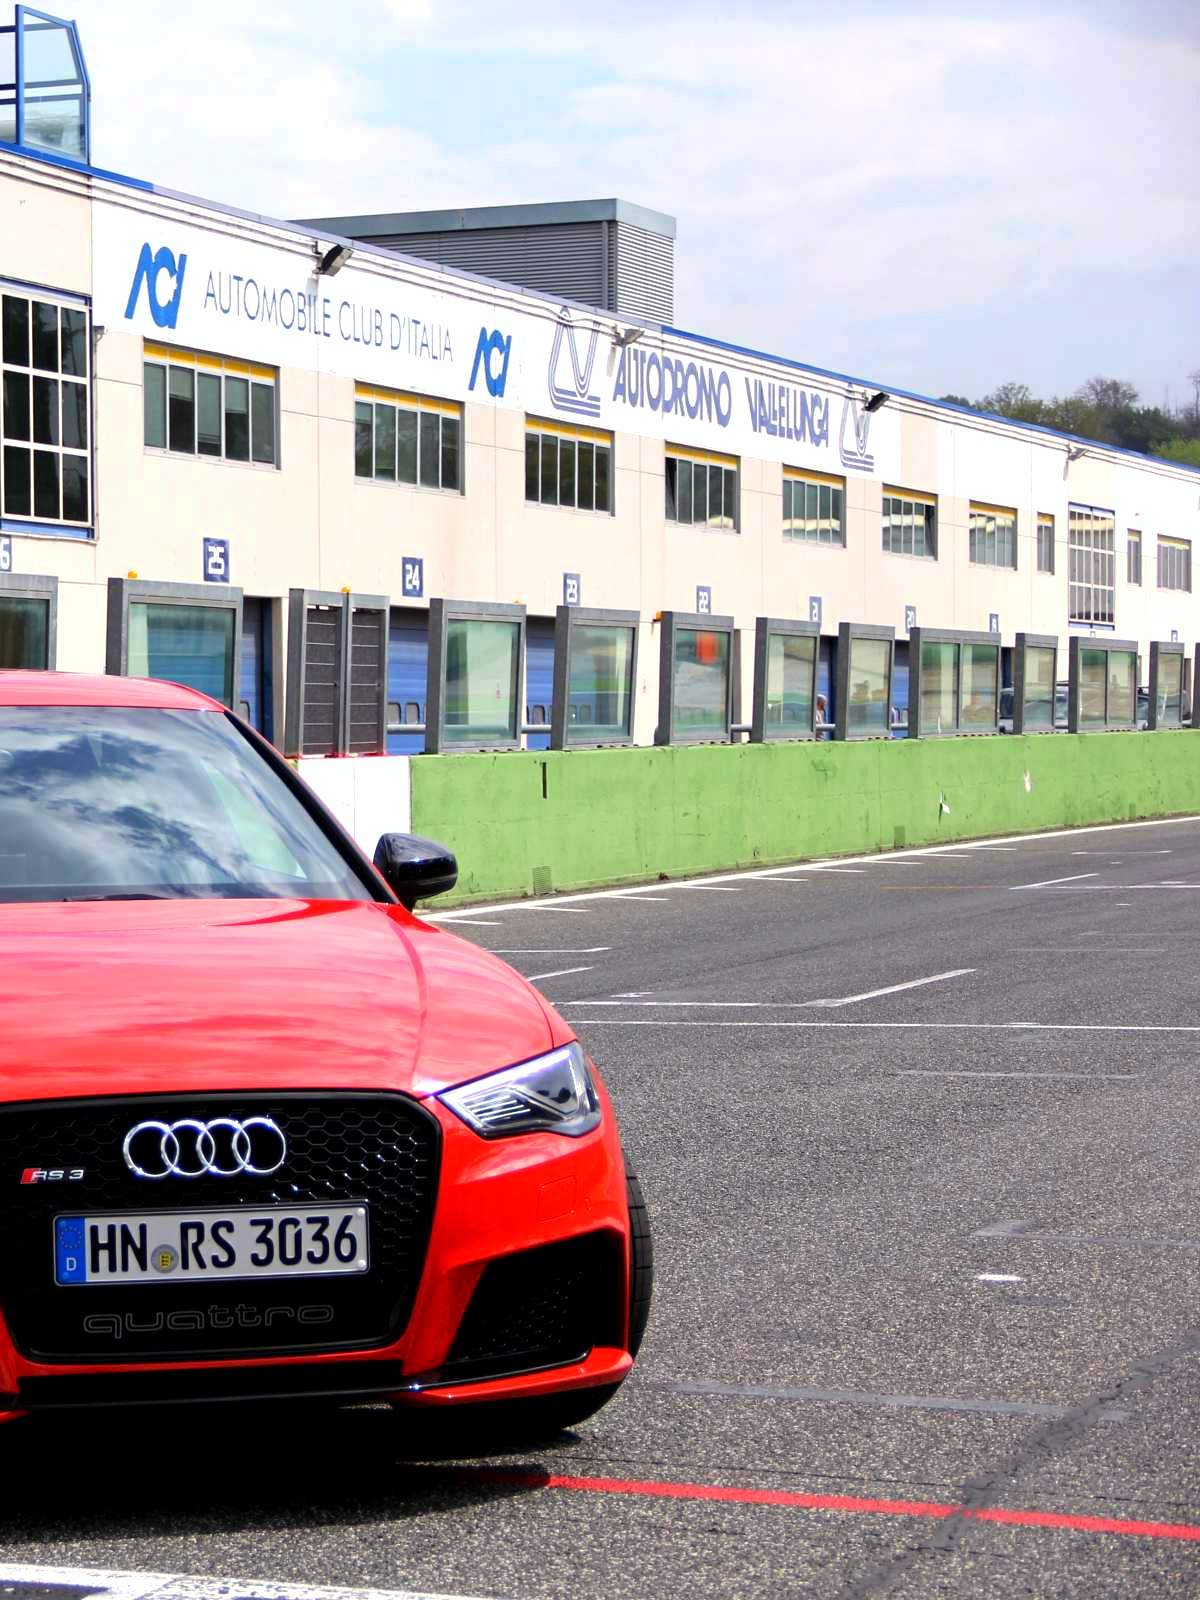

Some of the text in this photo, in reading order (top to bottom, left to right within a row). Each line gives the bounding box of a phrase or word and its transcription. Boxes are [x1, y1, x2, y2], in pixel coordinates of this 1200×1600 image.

[204, 271, 454, 362] AUTOMOBILE CLUB D'ITALIA
[613, 346, 830, 449] AUTODROMO VALLELUNGA
[208, 544, 226, 576] 25
[404, 563, 421, 591] 24
[89, 1215, 357, 1273] HN RS 3036
[65, 1257, 77, 1271] D
[83, 1304, 334, 1339] quattro
